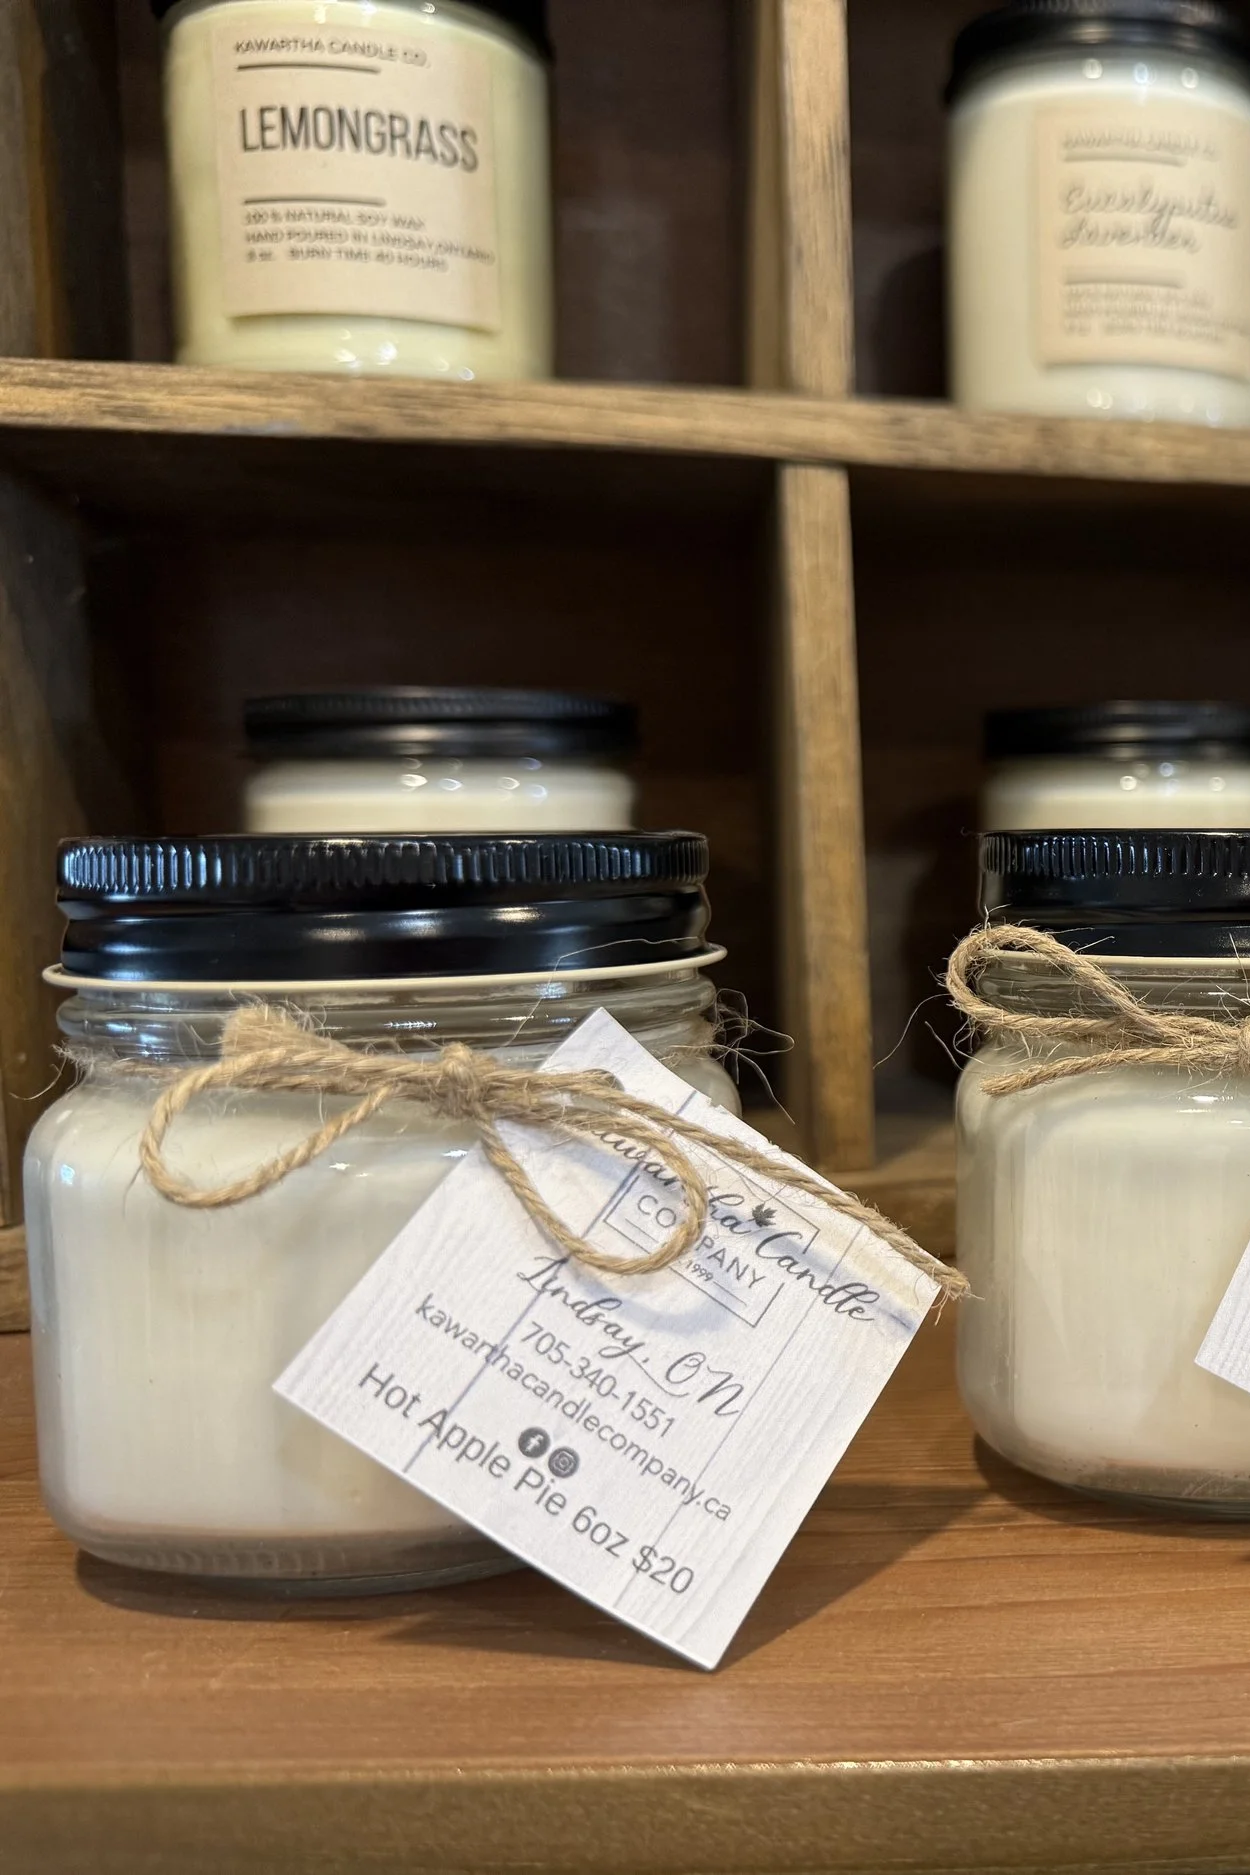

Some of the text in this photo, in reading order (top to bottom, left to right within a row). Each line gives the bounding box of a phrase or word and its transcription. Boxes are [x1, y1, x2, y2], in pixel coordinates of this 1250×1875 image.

[235, 38, 325, 54] KAWARTHA
[327, 39, 399, 62] CANDLE
[239, 105, 479, 172] LEMONGRASS
[637, 1194, 766, 1289] COPANY
[685, 1259, 714, 1283] 1999
[755, 1231, 875, 1321] Candle
[415, 1293, 732, 1522] kawarthacandlecompany.ca
[520, 1321, 677, 1439] 705-340-1551
[665, 1352, 745, 1416] ON
[358, 1362, 695, 1595] Hot Apple Pie 6oz $20
